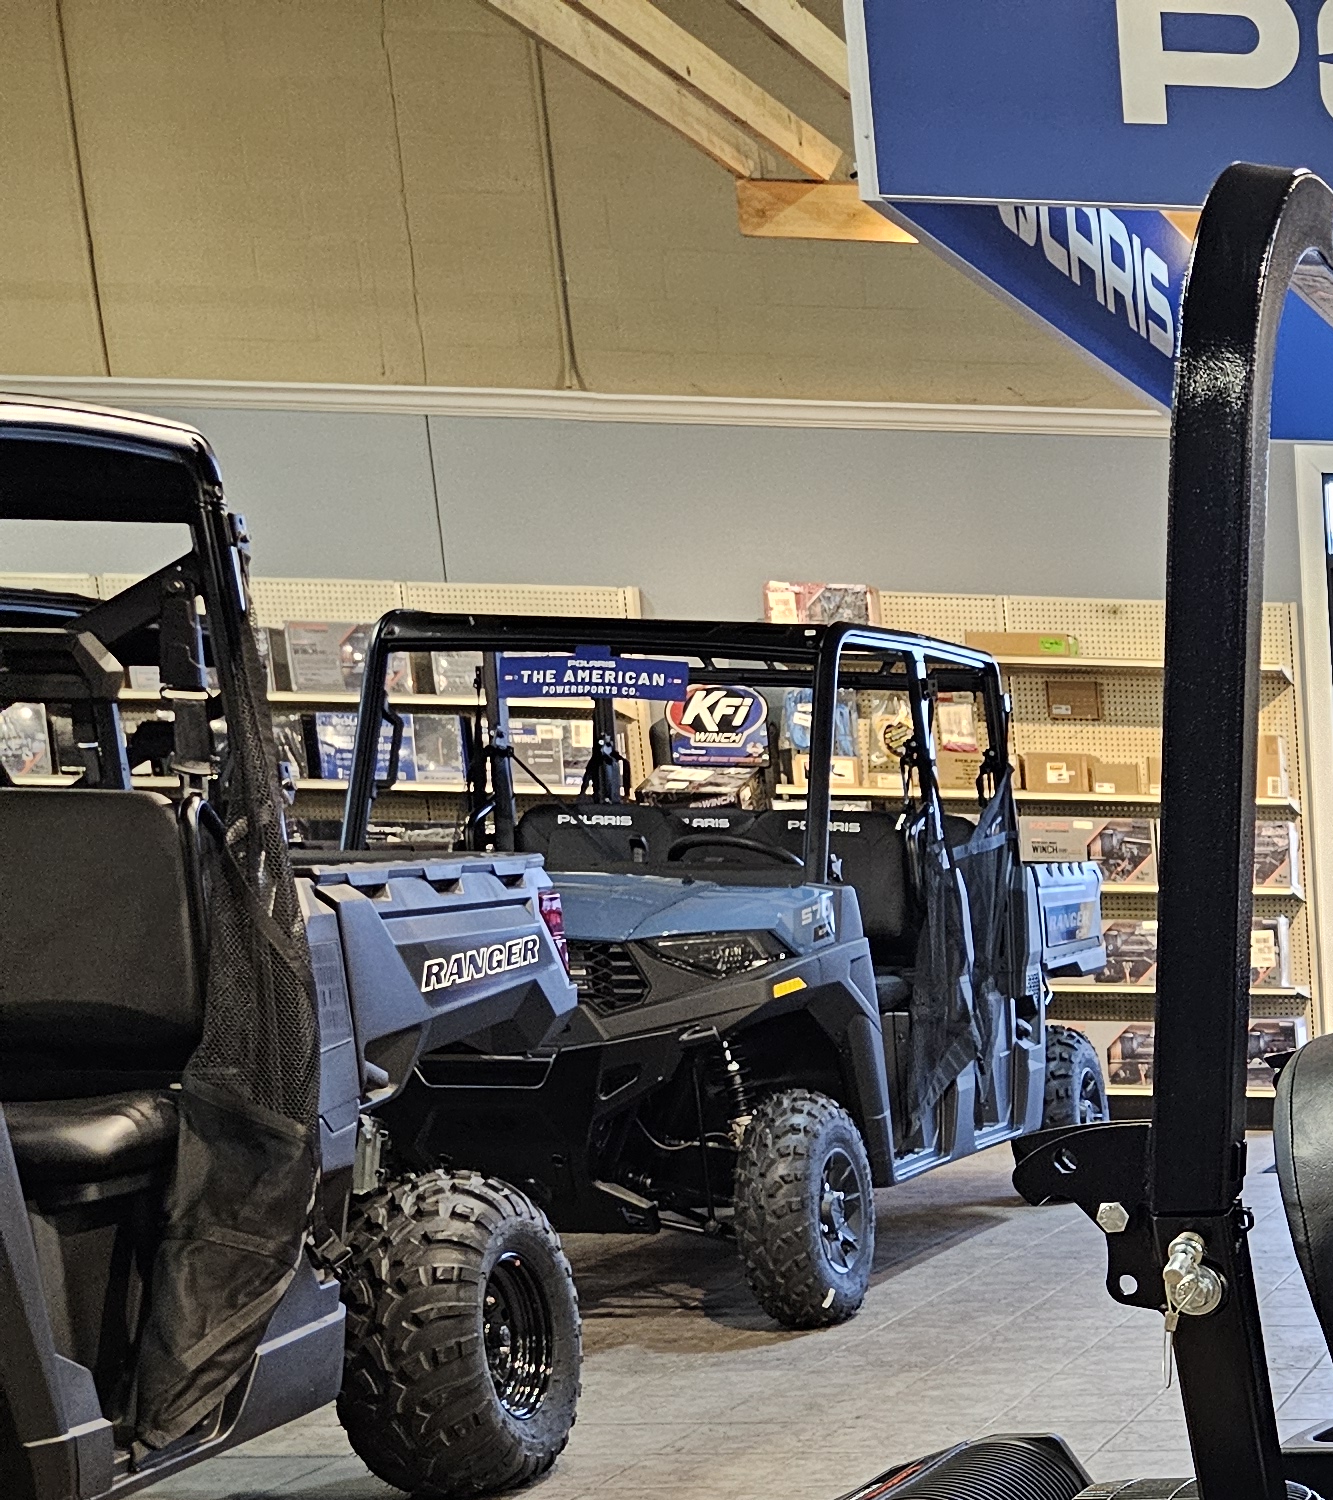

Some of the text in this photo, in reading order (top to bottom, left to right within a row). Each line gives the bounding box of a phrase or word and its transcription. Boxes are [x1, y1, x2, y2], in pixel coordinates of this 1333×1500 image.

[998, 204, 1174, 358] LARIS
[567, 659, 616, 668] POLARIS
[520, 669, 665, 686] THE AMERICAN
[542, 686, 617, 695] POWERSPORTS
[694, 731, 744, 744] WINCH
[702, 794, 735, 808] WINCH
[787, 819, 861, 833] POARIS
[1031, 845, 1058, 854] WINCH
[421, 934, 540, 993] RANGER
